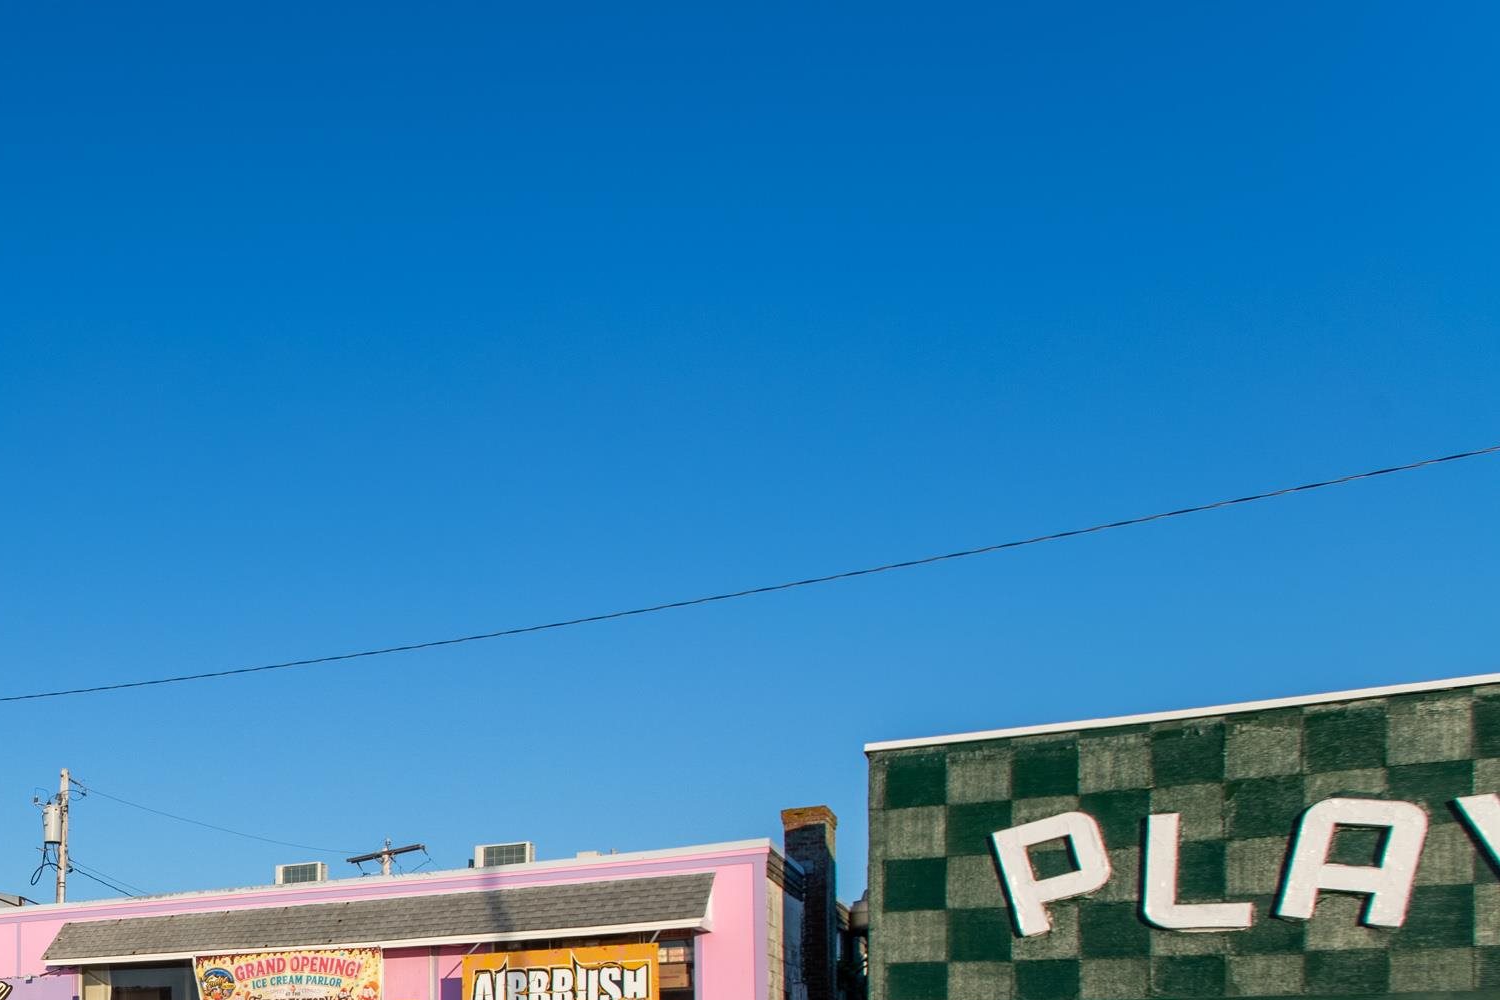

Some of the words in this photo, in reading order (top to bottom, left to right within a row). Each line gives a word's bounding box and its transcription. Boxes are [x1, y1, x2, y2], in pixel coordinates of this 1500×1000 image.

[234, 957, 286, 982] GRAND
[290, 956, 362, 978] OPENING!
[252, 978, 267, 989] ICE
[270, 975, 303, 988] CREAM
[306, 976, 342, 988] PARLOR
